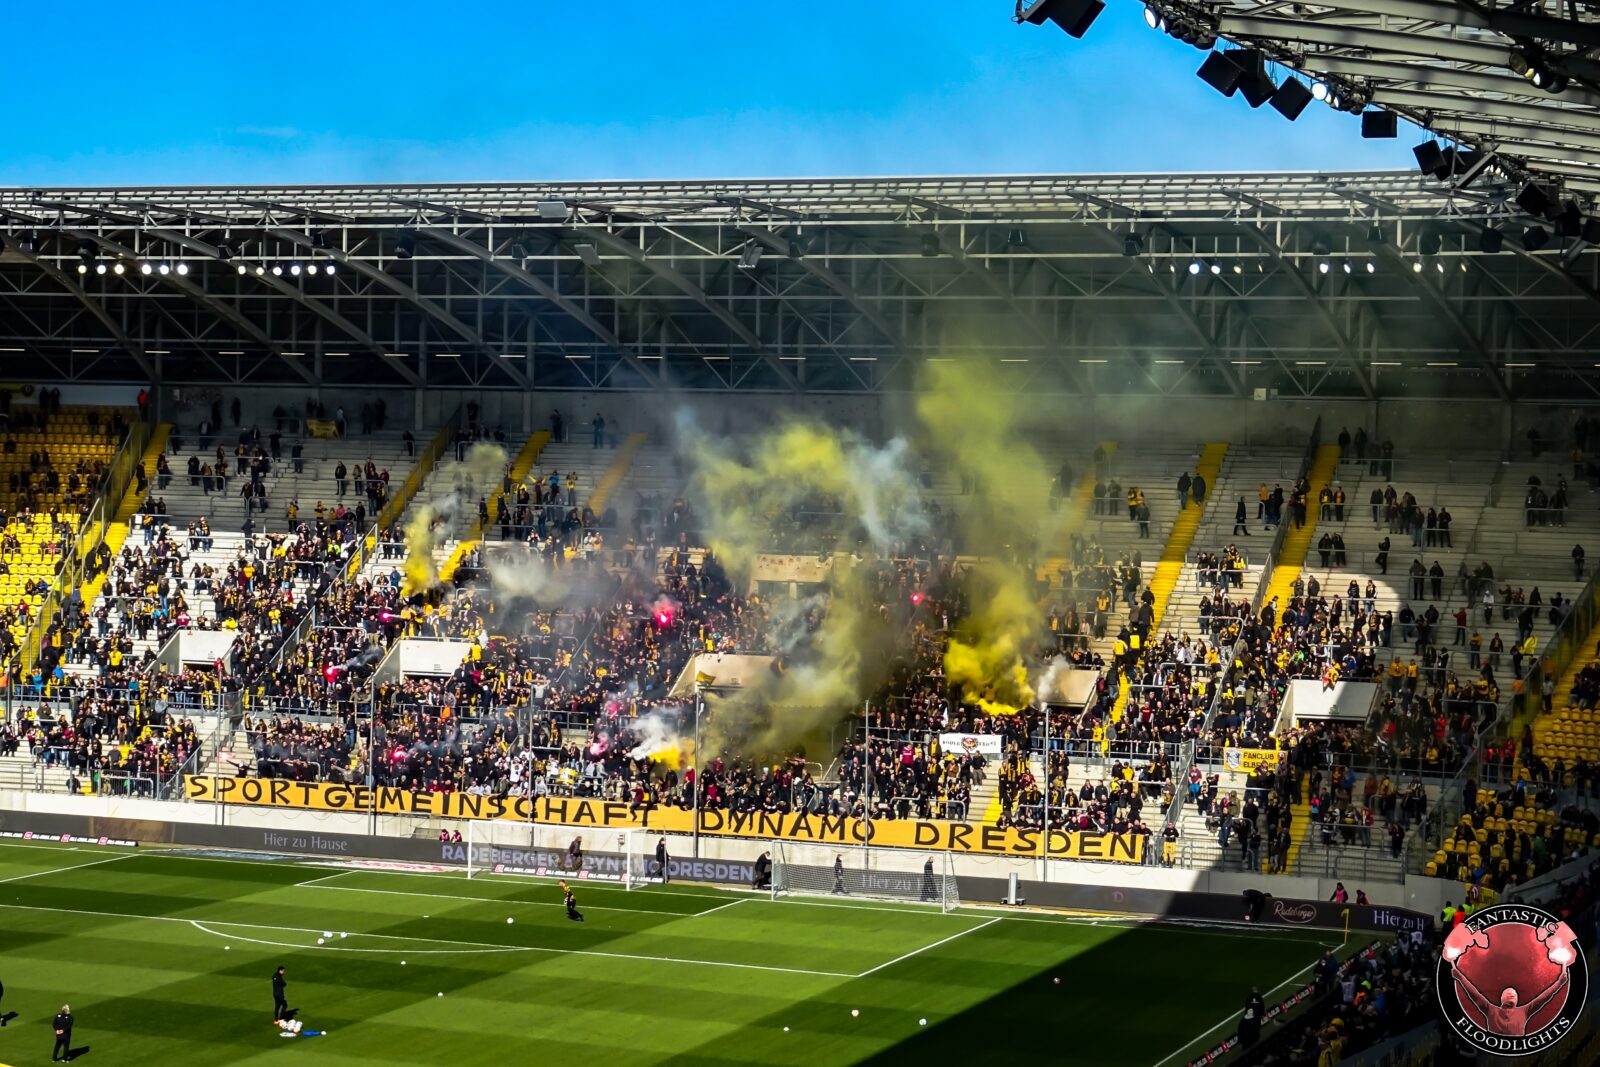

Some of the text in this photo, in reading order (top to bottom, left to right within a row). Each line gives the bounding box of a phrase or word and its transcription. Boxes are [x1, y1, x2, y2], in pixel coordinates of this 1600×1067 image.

[190, 775, 1137, 860] SPORTGEMEINSCHAFT DYNAMO DRESDEN
[263, 832, 348, 851] Hier zu Hause
[441, 844, 560, 867] RADEBERGER
[667, 861, 753, 882] DRESDEN
[1373, 910, 1400, 926] Hier
